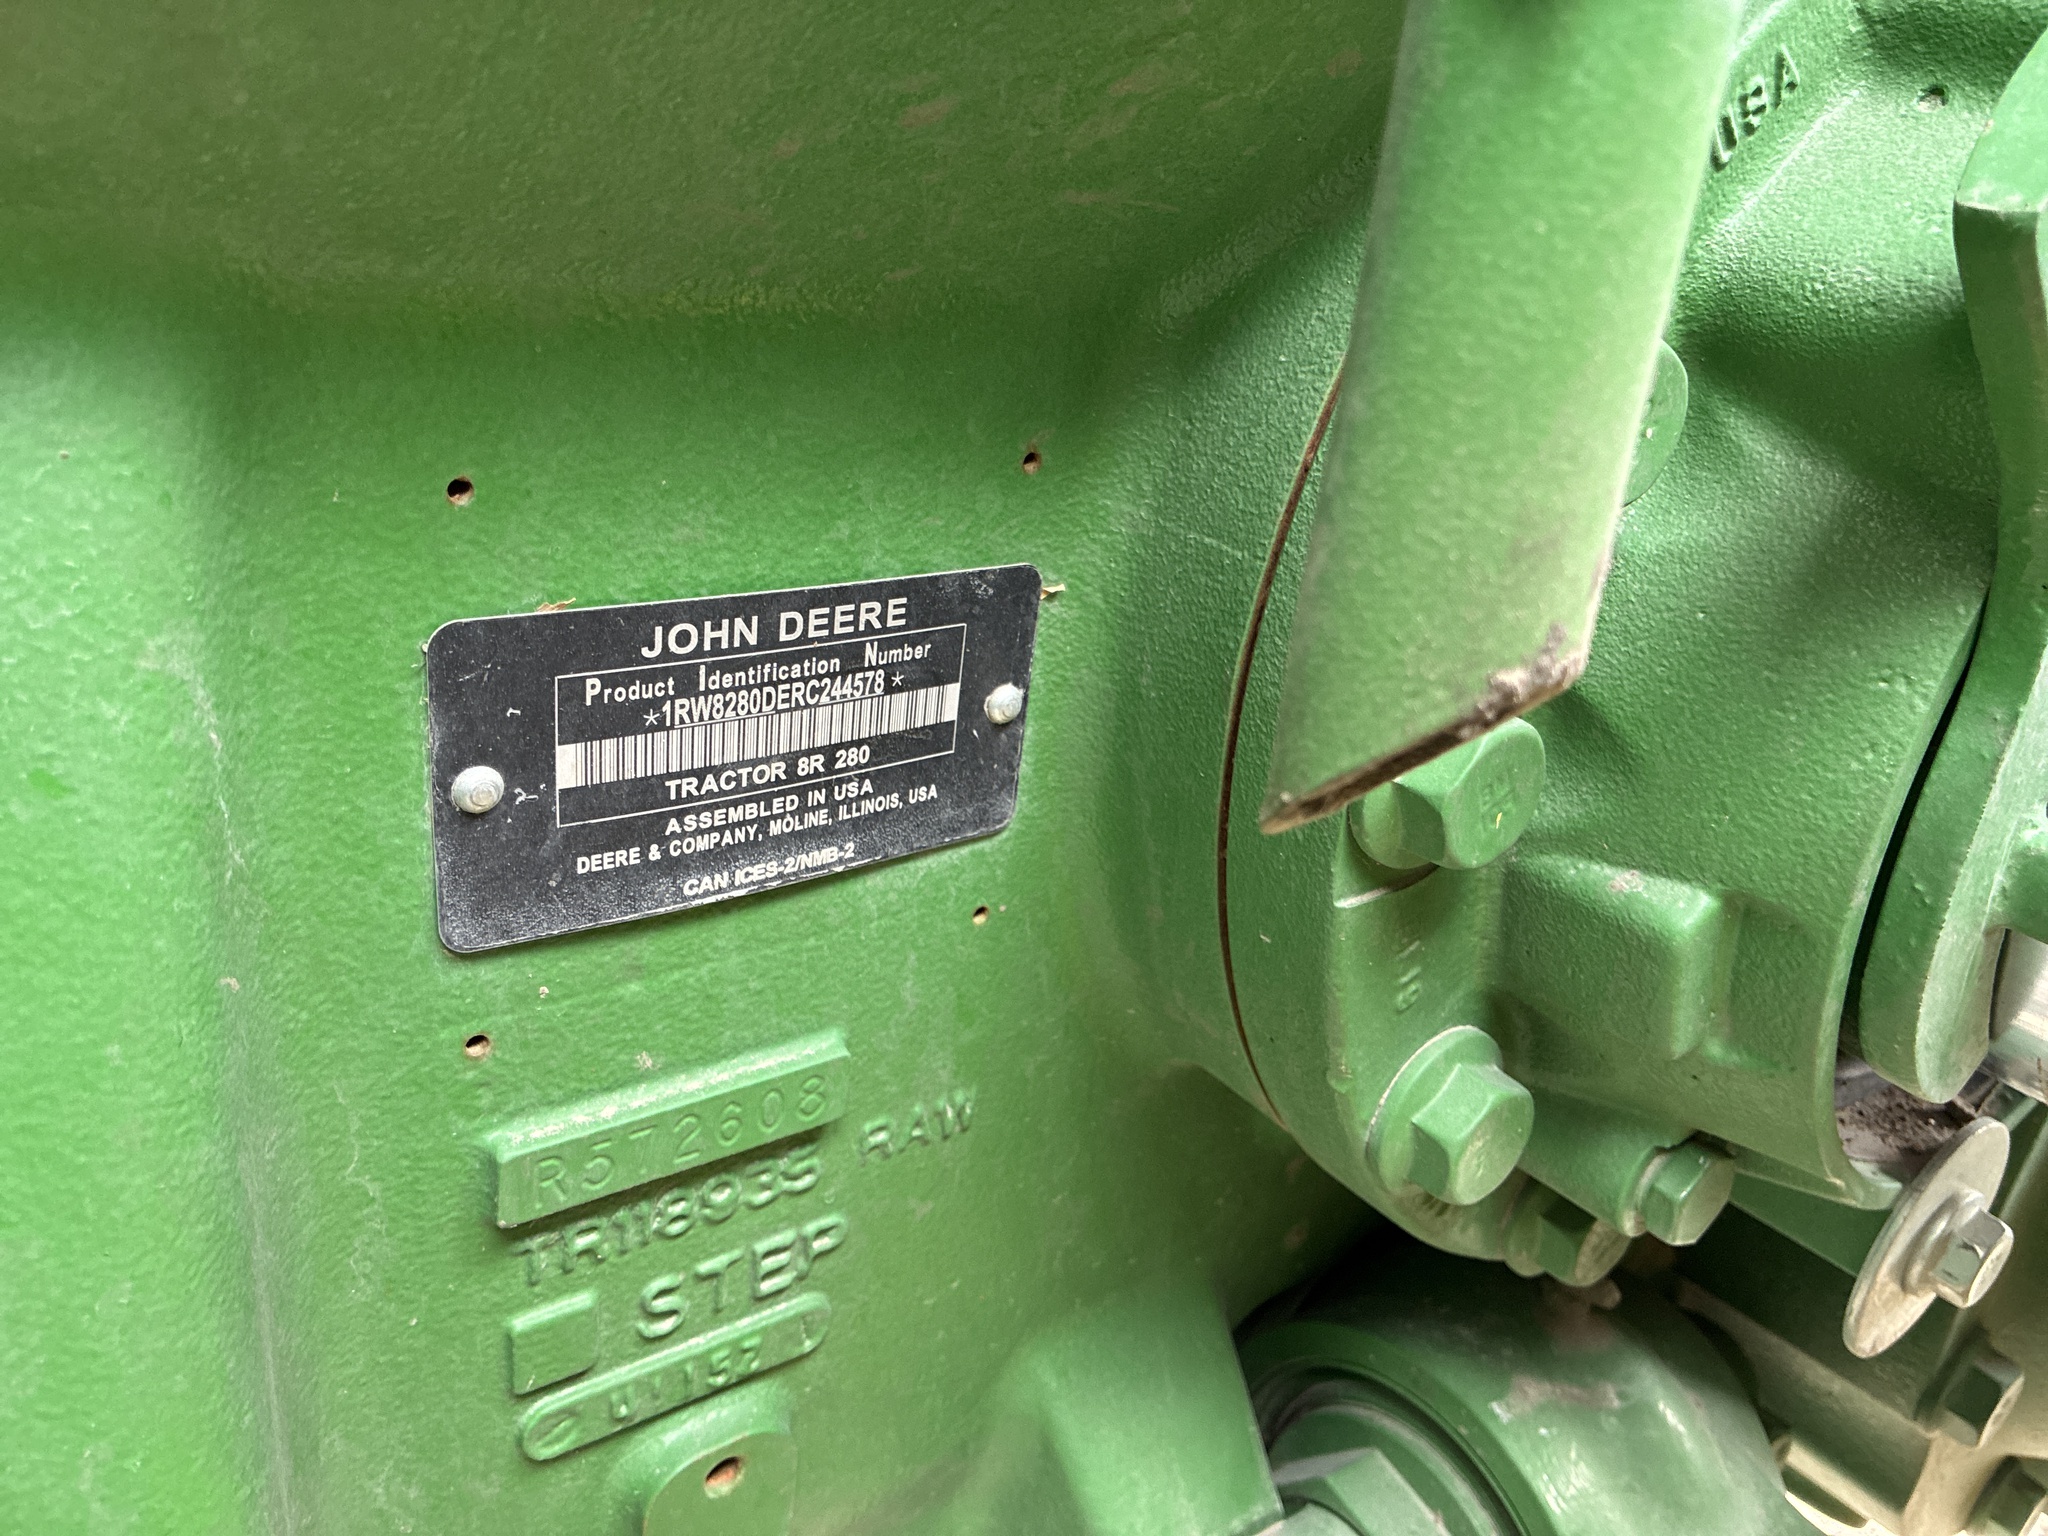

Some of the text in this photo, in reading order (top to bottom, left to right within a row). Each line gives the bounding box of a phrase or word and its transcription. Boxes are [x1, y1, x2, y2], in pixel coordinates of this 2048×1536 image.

[640, 597, 908, 659] JOHN DEERE
[585, 641, 932, 707] Product Identification Number
[664, 744, 871, 801] TRACTOR 8R 280
[576, 783, 938, 875] DEERE & COMPANY, MOLINE, ILLINOIS, USA
[664, 778, 874, 836] ASSEMBLED IN USA
[682, 842, 855, 897] CAN ICES-2/NMB-2
[534, 1073, 828, 1211] R572608
[858, 1088, 977, 1166] RAW
[635, 1210, 849, 1341] STEP
